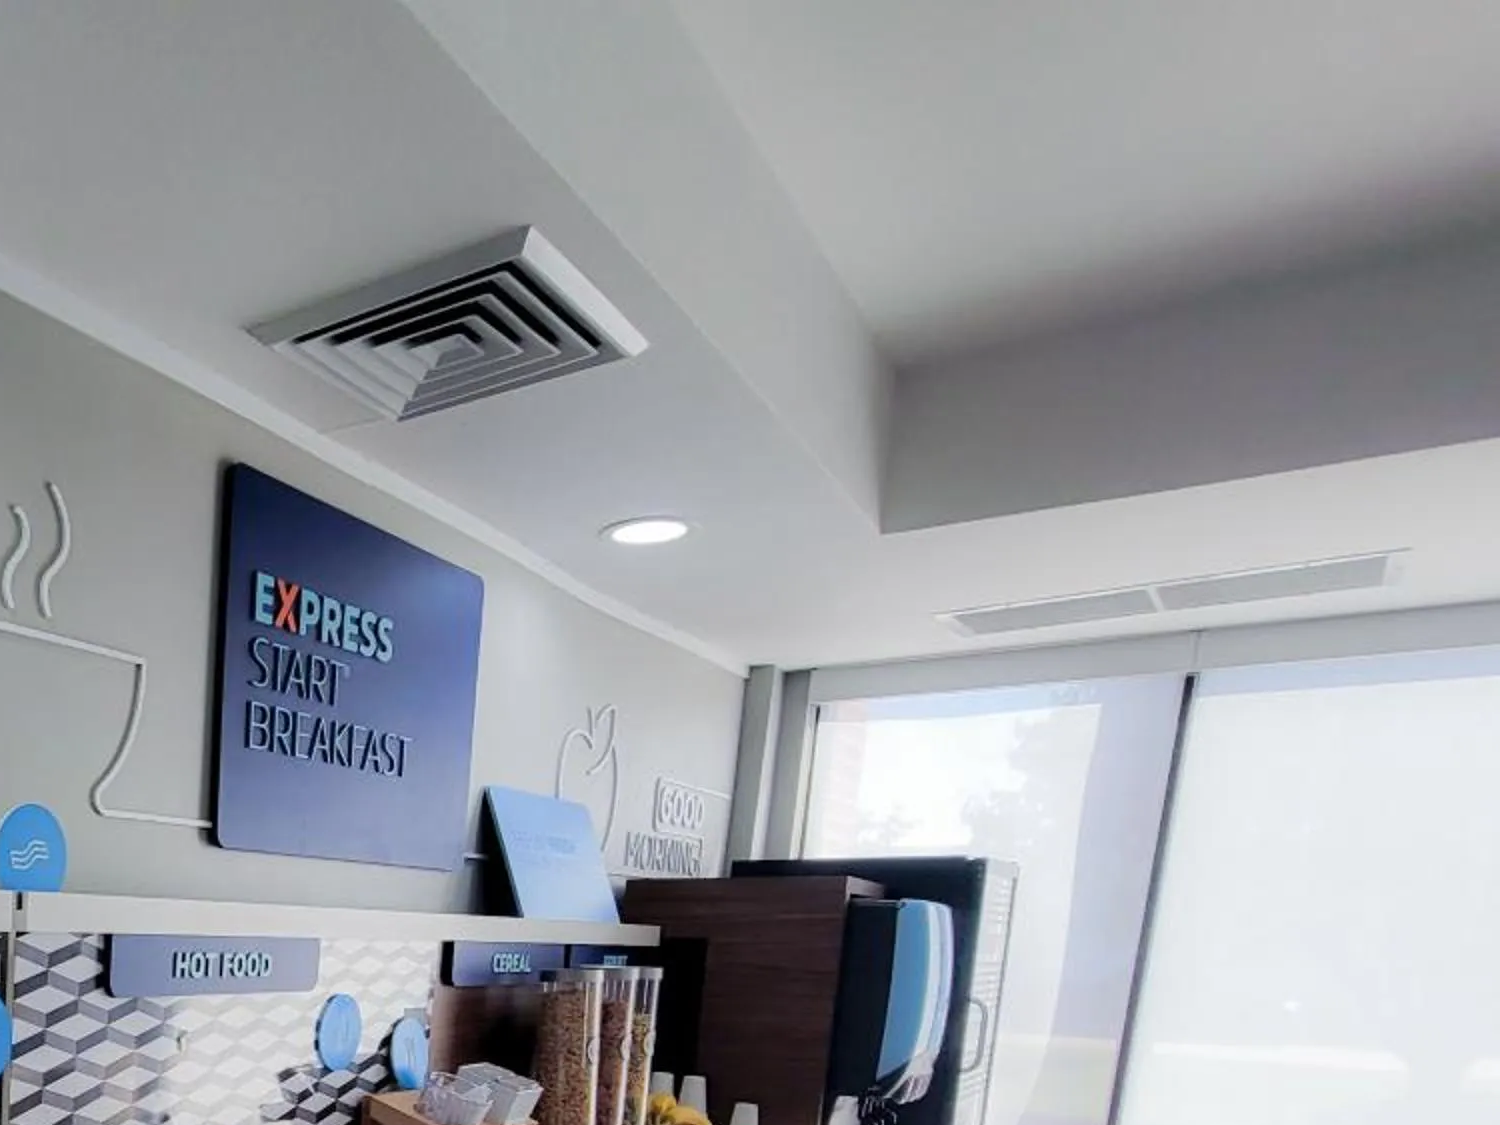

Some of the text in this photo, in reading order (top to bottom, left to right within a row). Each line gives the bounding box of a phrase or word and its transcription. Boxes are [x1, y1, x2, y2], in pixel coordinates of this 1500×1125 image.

[254, 571, 394, 664] EXPRESS
[246, 638, 346, 706] START
[244, 700, 412, 778] BREAKFAST
[659, 785, 704, 830] GOOD
[172, 951, 273, 979] HOT FOOD
[492, 953, 532, 974] CEREAL
